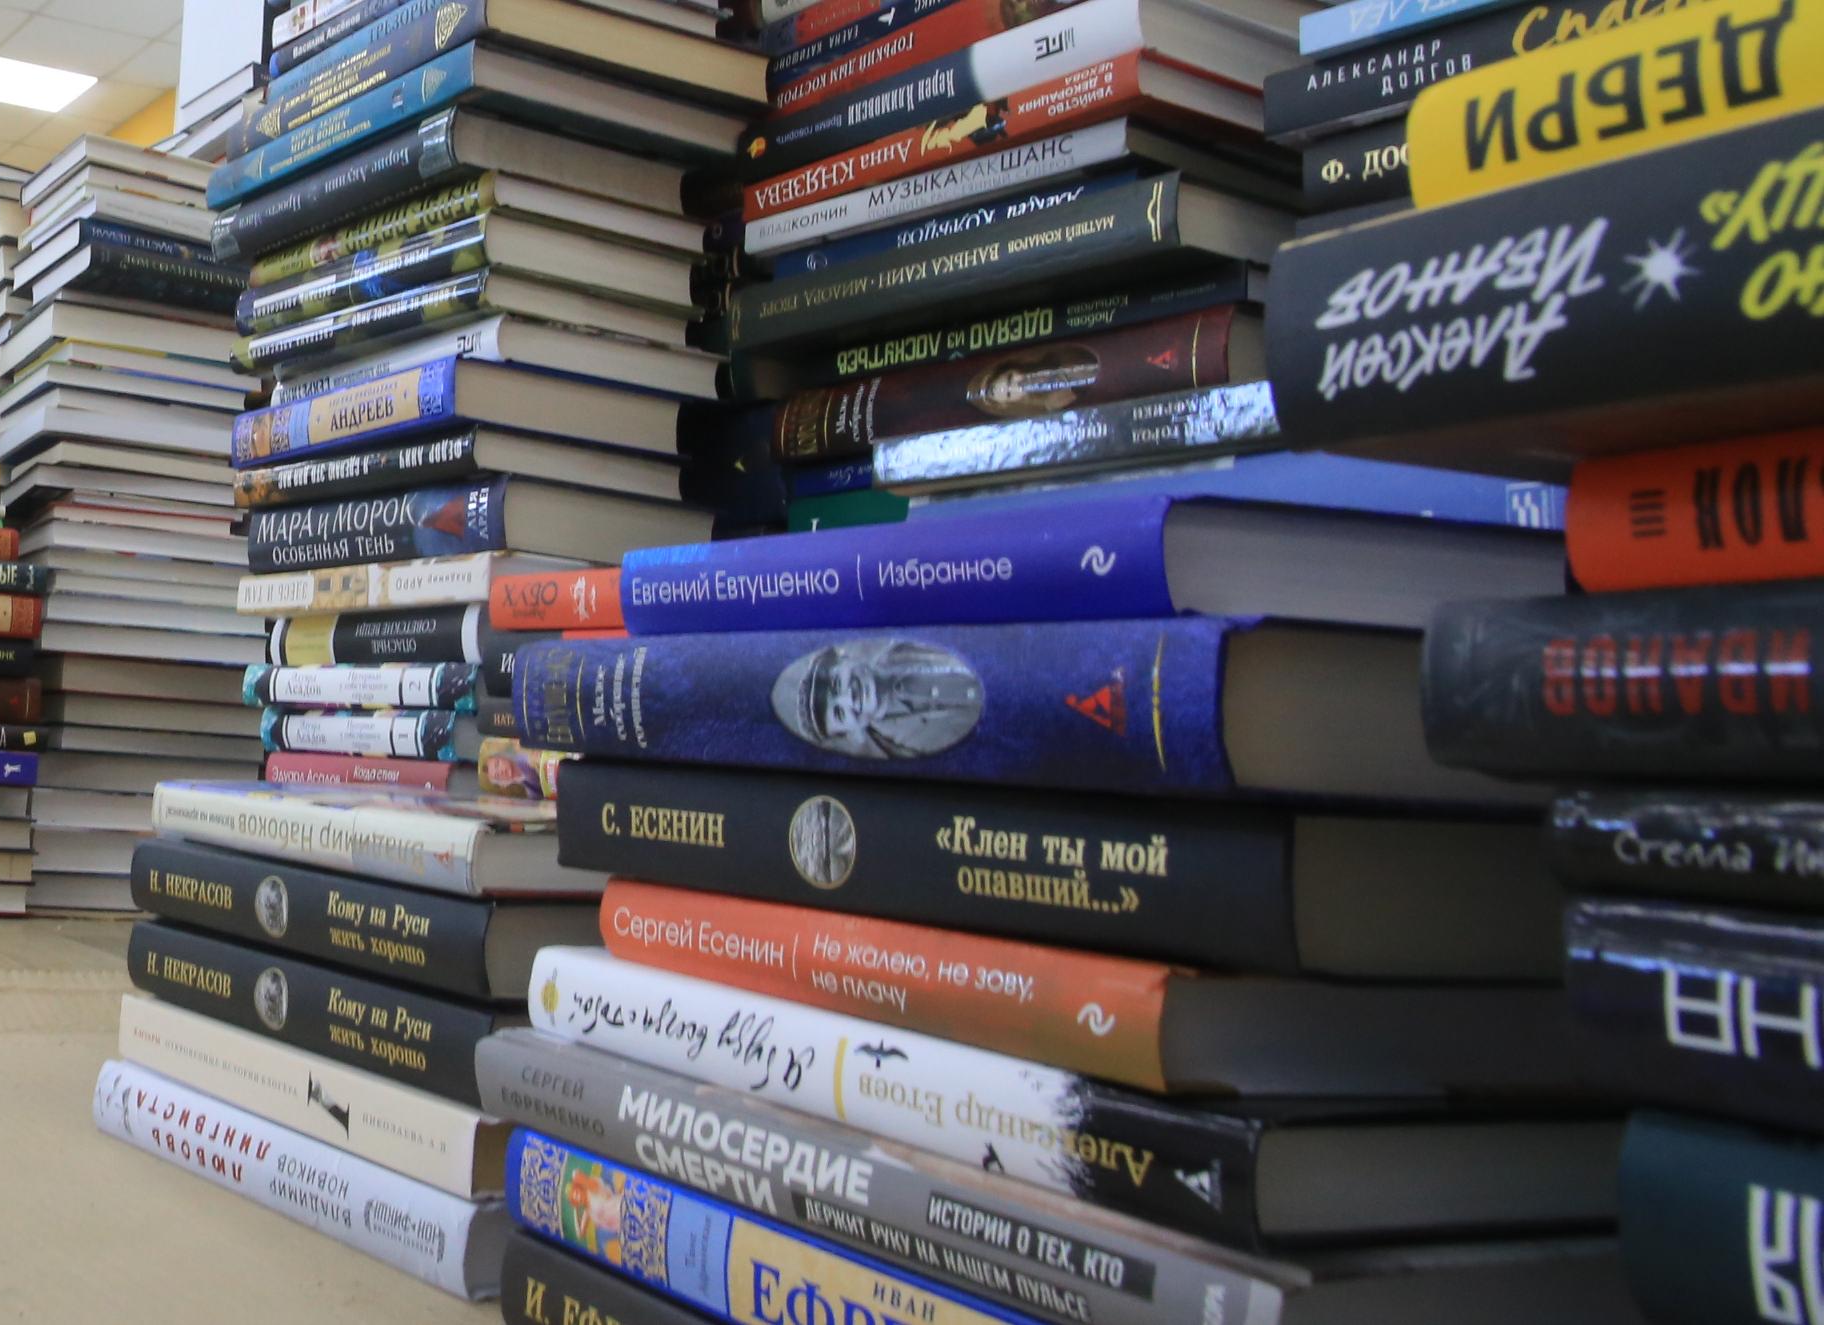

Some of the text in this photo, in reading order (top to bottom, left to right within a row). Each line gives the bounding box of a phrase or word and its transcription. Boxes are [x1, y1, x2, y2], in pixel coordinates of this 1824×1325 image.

[828, 22, 859, 48] ЕЛЕНА
[858, 31, 915, 69] ГОРЬКИЙ
[829, 56, 857, 80] ДЫМ
[1306, 39, 1442, 93] АЛЕКСАНДР
[1380, 53, 1473, 96] ДОЛГОВ
[1465, 2, 1796, 173] ДЕБРИ
[846, 66, 956, 126] Керен Климовски
[1016, 72, 1113, 115] В ДЕКОРАЦИЯХ
[1047, 85, 1114, 117] УБИЙСТВО
[815, 112, 843, 129] Время
[324, 147, 411, 195] Борис Акунин
[858, 137, 914, 167] Анна
[1320, 157, 1351, 185] Ф.
[753, 156, 856, 211] КНЯЗЕВА
[1007, 227, 1063, 255] КОМАРОВ
[1064, 214, 1116, 240] МАТВЕЙ
[877, 260, 927, 288] КАИН
[931, 242, 1001, 276] ВАНЬКА
[1314, 217, 1609, 329] ИВАНОВ
[836, 306, 1054, 376] ОДЕЯЛО ЛОСКУТЬЕВ
[1066, 307, 1114, 330] Любовь
[1317, 293, 1568, 401] Алексей
[330, 397, 395, 433] АНДРЕЕВ
[257, 493, 422, 544] МАРА МОРОК
[272, 533, 395, 567] ОСОБЕННАЯ ТЕНЬ
[878, 555, 1014, 590] Избранное
[278, 581, 309, 603] ЗДЕСЬ
[395, 570, 473, 592] Владимир АРРО
[631, 567, 840, 607] Евгений Евтушенко
[371, 637, 417, 654] ОПАСНЫЕ
[284, 679, 322, 697] Асадов
[1543, 628, 1811, 716] ИВАНОВ
[238, 813, 314, 851] Набоков
[600, 803, 725, 849] С. ЕСЕНИН
[934, 815, 1169, 877] «Клен ты мой
[149, 869, 233, 911] Н. НЕКРАСОВ
[956, 864, 1140, 912] опавший...»
[327, 890, 431, 938] Кому на Руси
[612, 906, 784, 967] Сергей Есенин
[328, 926, 426, 967] жить хорошо
[812, 932, 1035, 1002] Не жалею, не зову,
[146, 951, 232, 999] Н. НЕКРАСОВ
[810, 971, 909, 1014] не плачу
[328, 986, 432, 1042] Кому на Руси
[329, 1023, 427, 1072] жить хорошо
[717, 1008, 777, 1092] буду
[782, 1045, 816, 1092] Я
[521, 1064, 585, 1101] СЕРГЕЙ
[136, 1088, 272, 1162] ЛИНГВИСТА
[501, 1086, 605, 1137] ЕФРЕМЕНКО
[857, 1074, 1154, 1188] Александр Етоев
[151, 1127, 243, 1183] ЛЮБОВЬ
[618, 1084, 874, 1206] МИЛОСЕРДИЕ
[275, 1153, 350, 1199] НОВИКОВ
[634, 1133, 778, 1216] СМЕРТИ
[268, 1179, 353, 1228] ВЛАДИМИР
[804, 1198, 1092, 1323] ДЕРЖИТ РУКУ НА НАШЕМ ПУЛЬСЕ
[928, 1195, 1126, 1289] ИСТОРИИ О ТЕХ, КТО
[525, 1276, 551, 1324] И.
[871, 1281, 937, 1321] ИВАН
